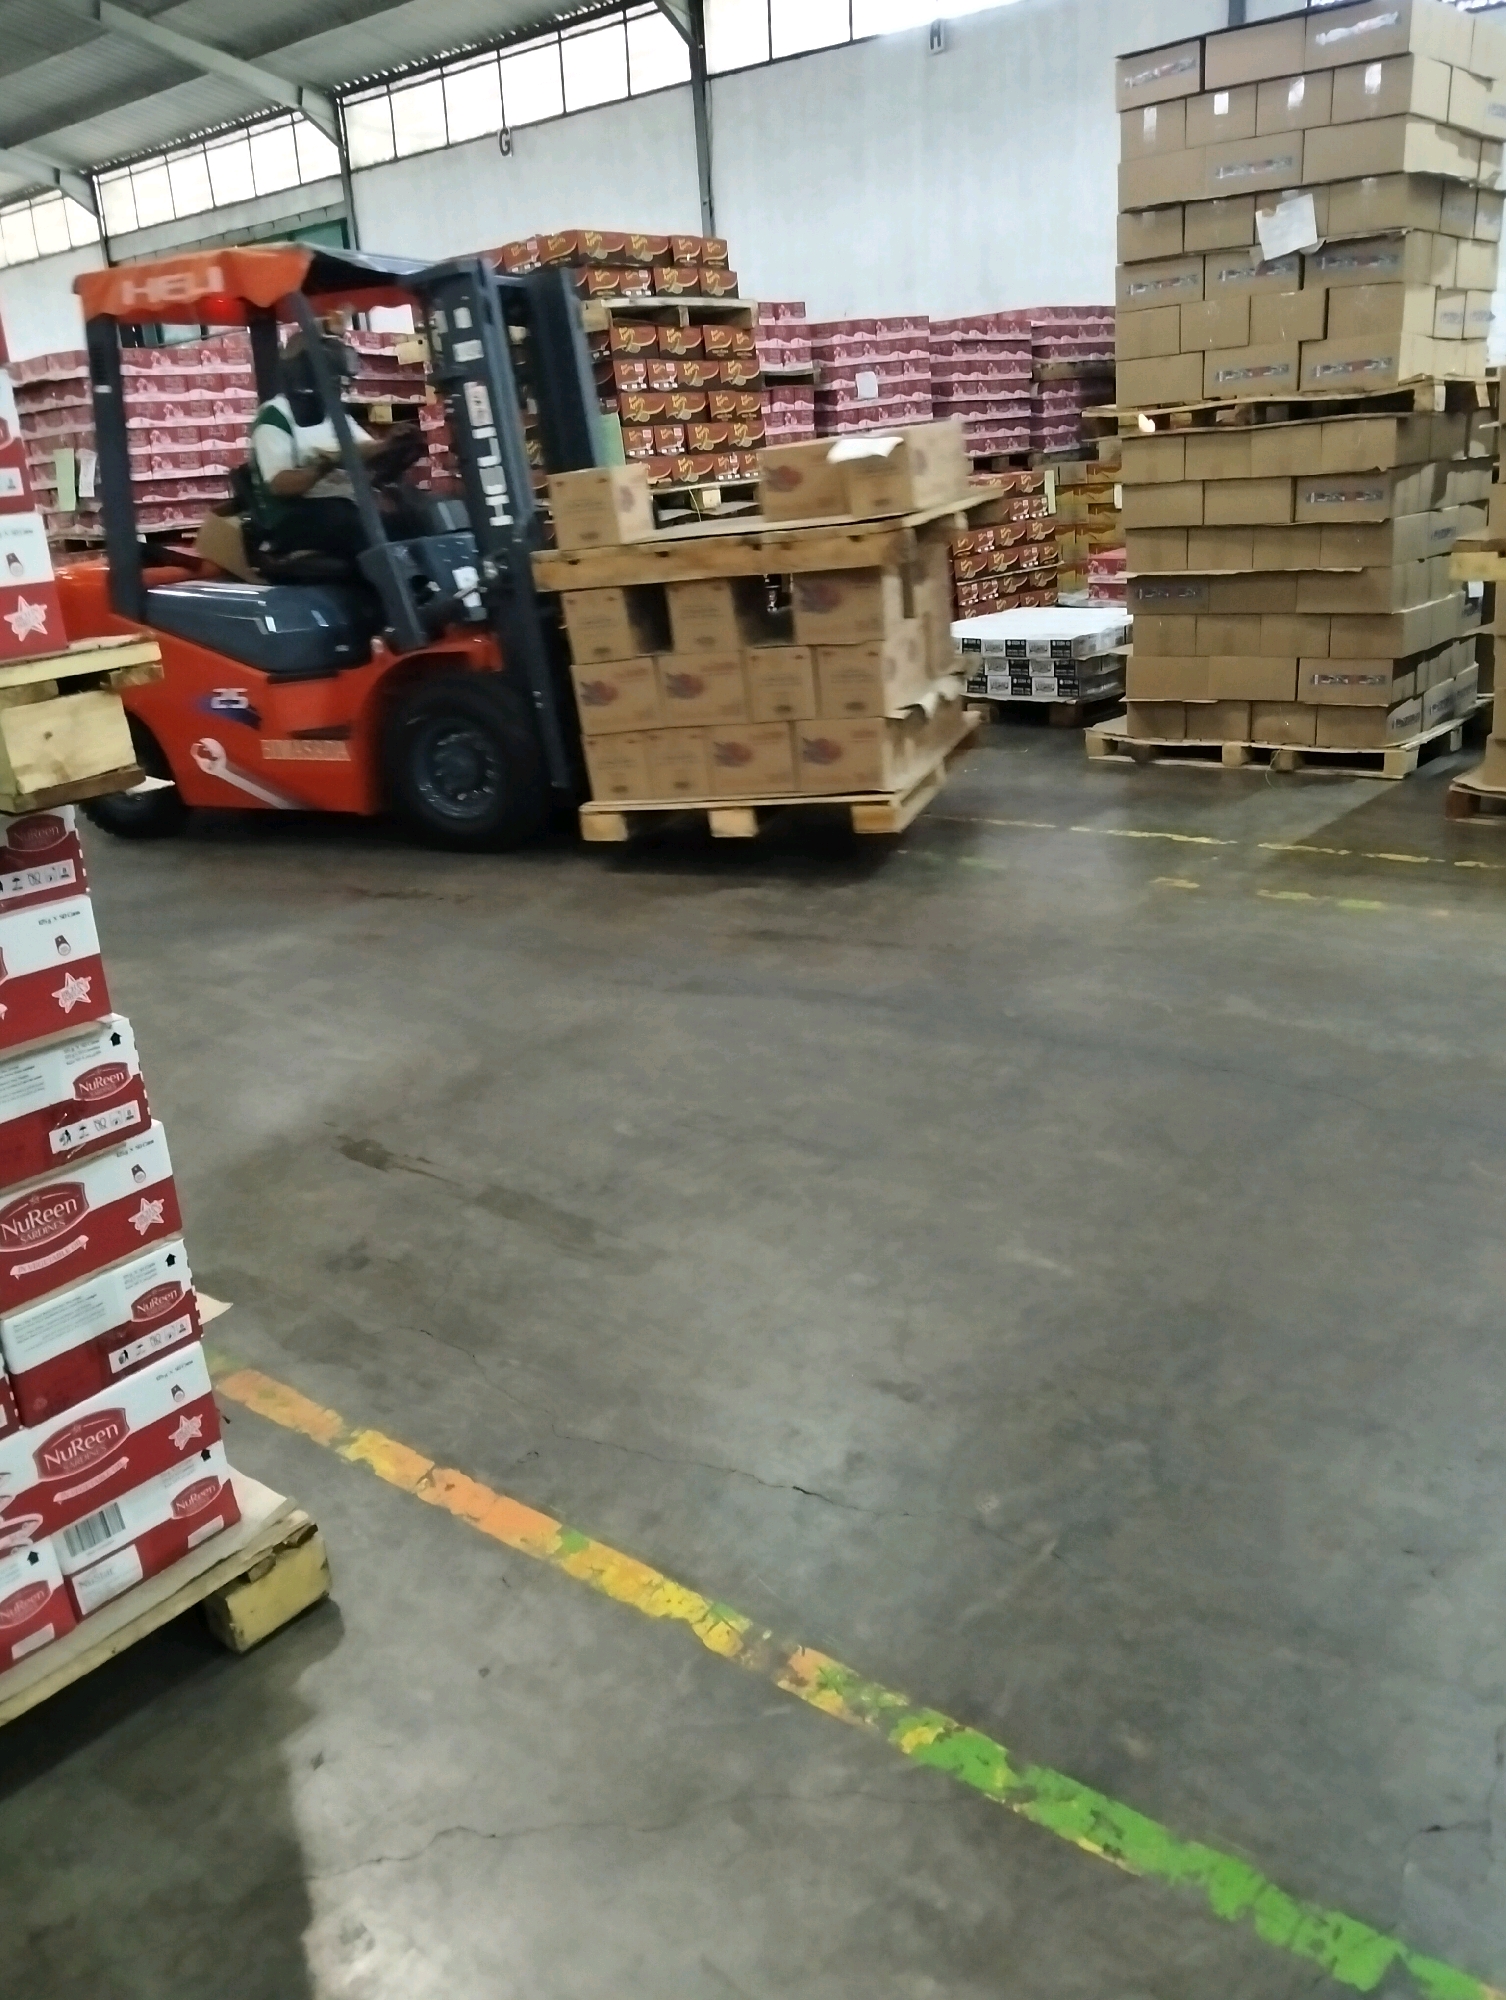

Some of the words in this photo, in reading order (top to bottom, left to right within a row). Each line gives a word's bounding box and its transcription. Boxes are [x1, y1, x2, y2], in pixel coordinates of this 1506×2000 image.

[499, 128, 511, 156] G
[121, 266, 225, 305] HELI
[211, 688, 249, 709] 25
[78, 1071, 125, 1093] NuReen
[0, 1197, 79, 1241] NuReen
[20, 1219, 67, 1245] SARDINES
[136, 1289, 178, 1314] NuReen
[43, 1423, 119, 1470] NuReen
[175, 1483, 216, 1511] NuReen
[0, 1590, 45, 1621] NuReen
